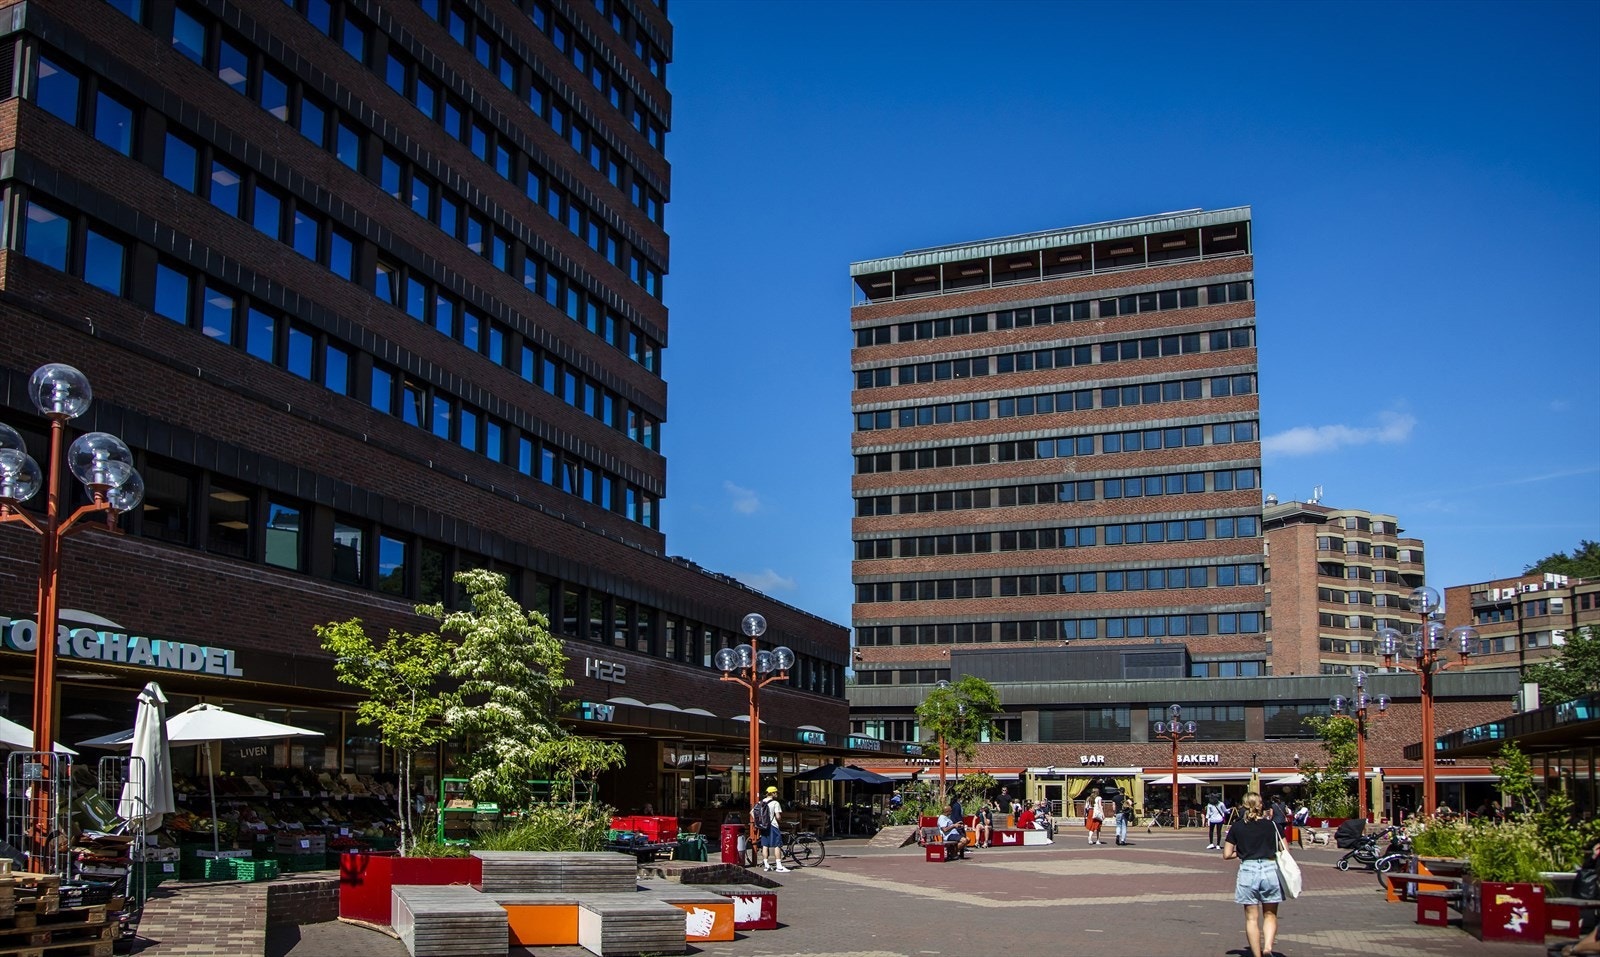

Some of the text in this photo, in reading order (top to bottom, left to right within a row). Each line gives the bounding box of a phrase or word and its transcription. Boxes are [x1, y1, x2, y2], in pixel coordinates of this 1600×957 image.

[585, 657, 626, 684] H22
[1080, 755, 1105, 764] BAR
[1176, 754, 1219, 764] BAKERI
